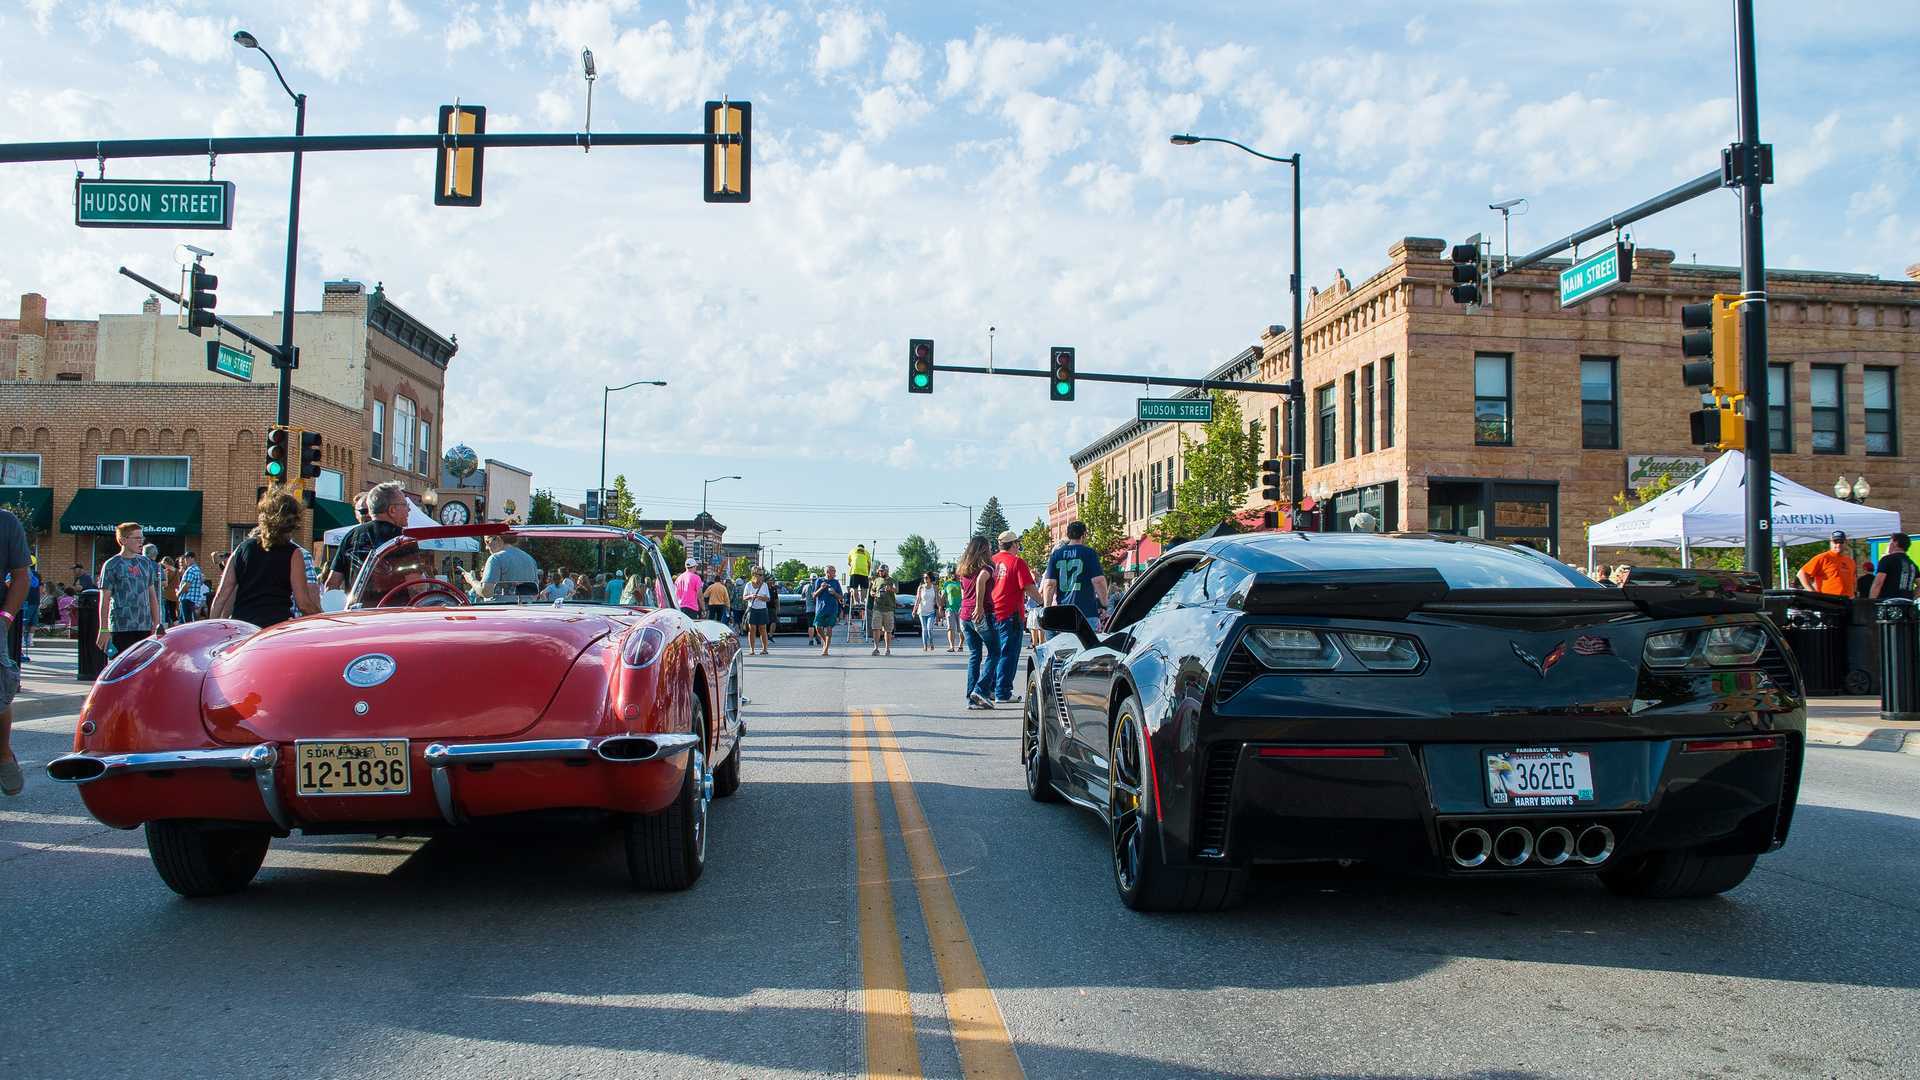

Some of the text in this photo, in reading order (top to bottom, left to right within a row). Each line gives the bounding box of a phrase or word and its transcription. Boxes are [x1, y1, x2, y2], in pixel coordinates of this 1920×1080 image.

[84, 193, 218, 213] HUDSON STREET
[1562, 256, 1616, 295] MAIN STREET
[1142, 405, 1209, 416] HUDSON STREET
[1760, 519, 1768, 529] B
[1063, 548, 1077, 559] FAN
[1056, 558, 1083, 592] 12
[385, 746, 399, 757] 60
[1516, 762, 1575, 790] 362EG
[1515, 797, 1539, 806] HARRY
[1541, 796, 1574, 806] BROWN'S
